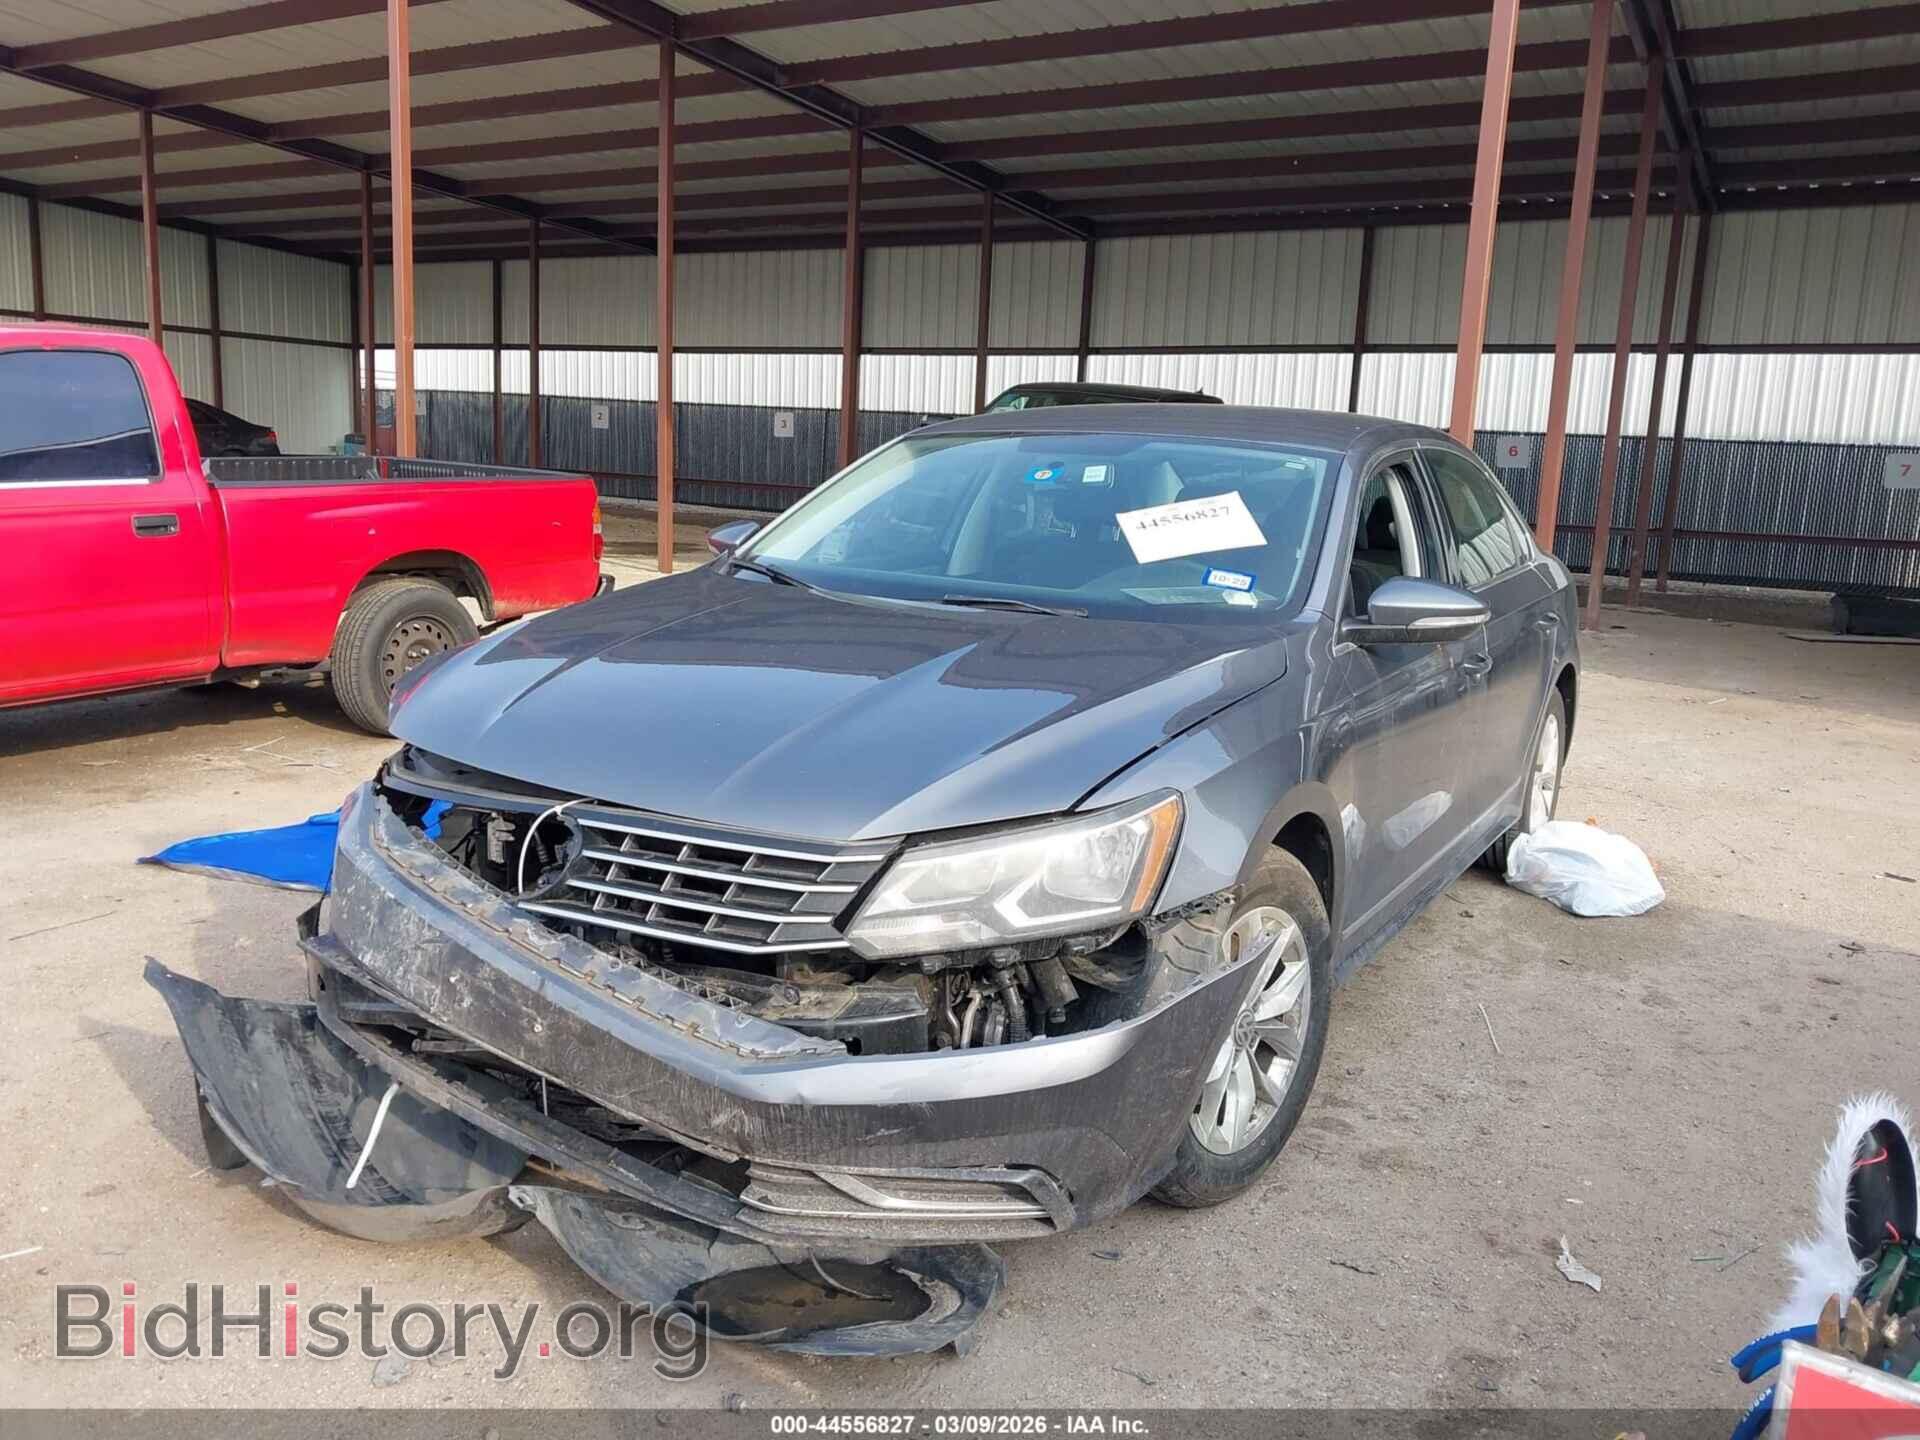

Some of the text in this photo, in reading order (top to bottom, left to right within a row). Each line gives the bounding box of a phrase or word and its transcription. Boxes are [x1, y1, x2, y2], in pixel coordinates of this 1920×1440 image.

[596, 411, 603, 421] 2
[780, 419, 787, 429] 3
[1508, 445, 1518, 457] 6
[1900, 464, 1911, 476] 7
[1135, 505, 1230, 530] 44556827
